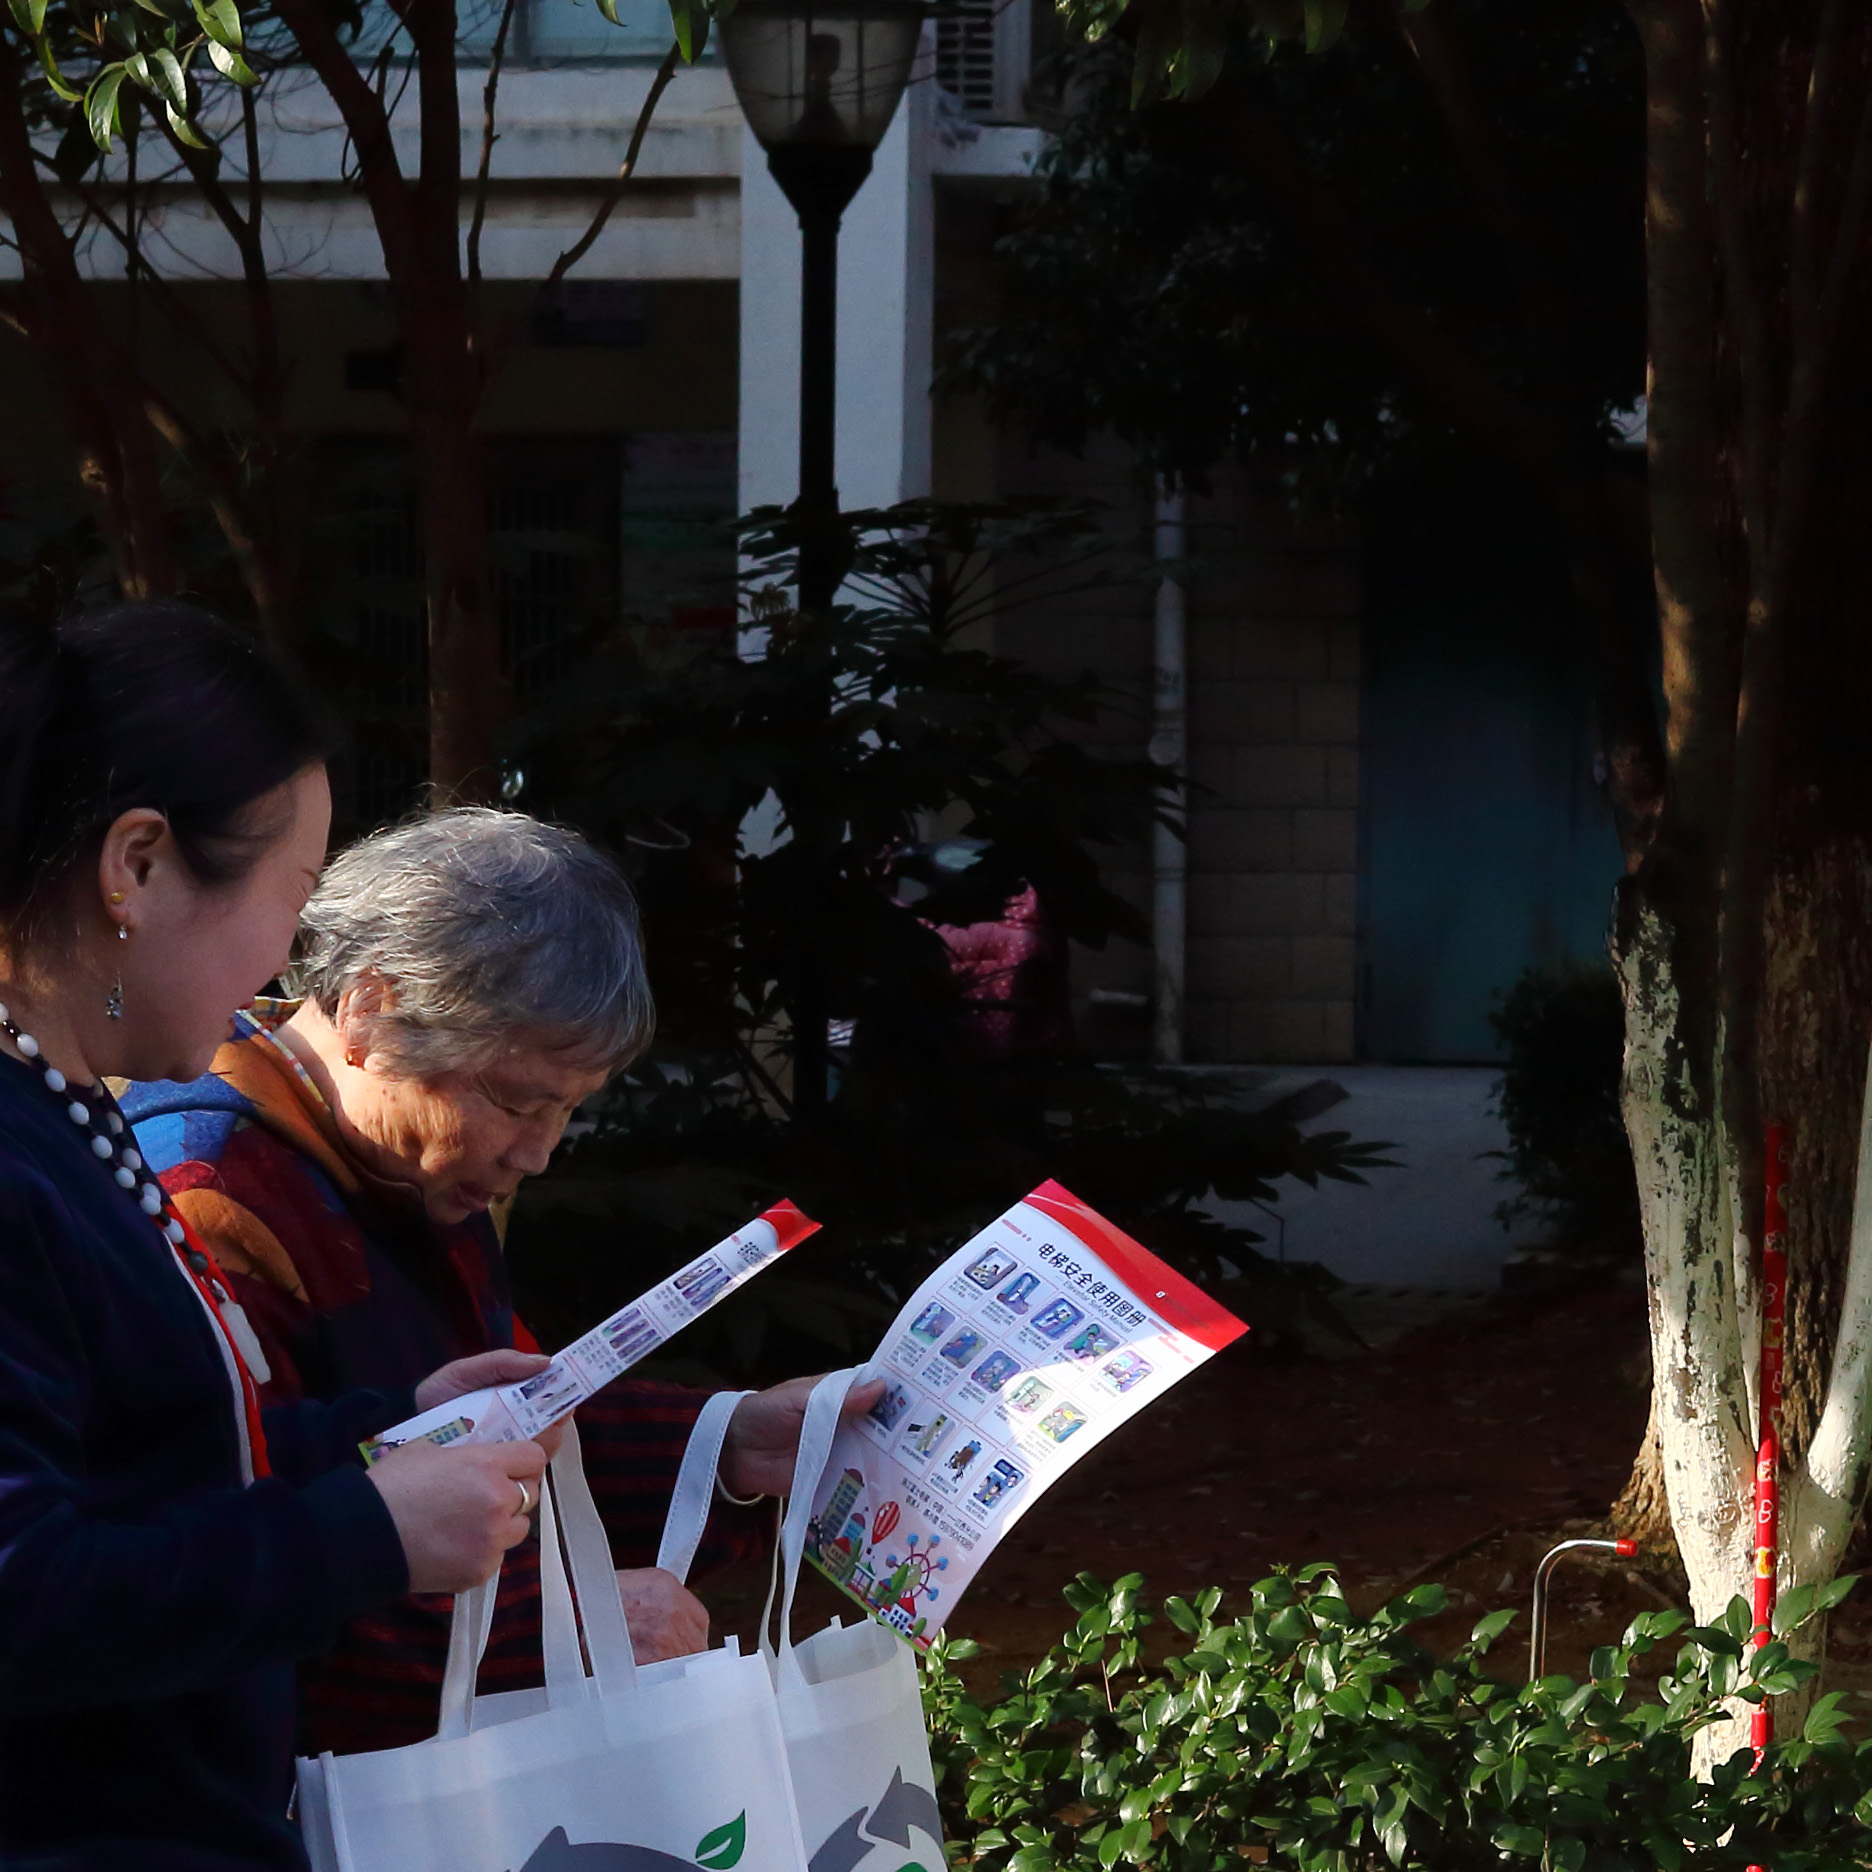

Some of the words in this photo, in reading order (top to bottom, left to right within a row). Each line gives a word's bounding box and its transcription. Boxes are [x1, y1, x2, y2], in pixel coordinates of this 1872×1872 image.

[1038, 1243, 1147, 1328] 电梯安全使用图册
